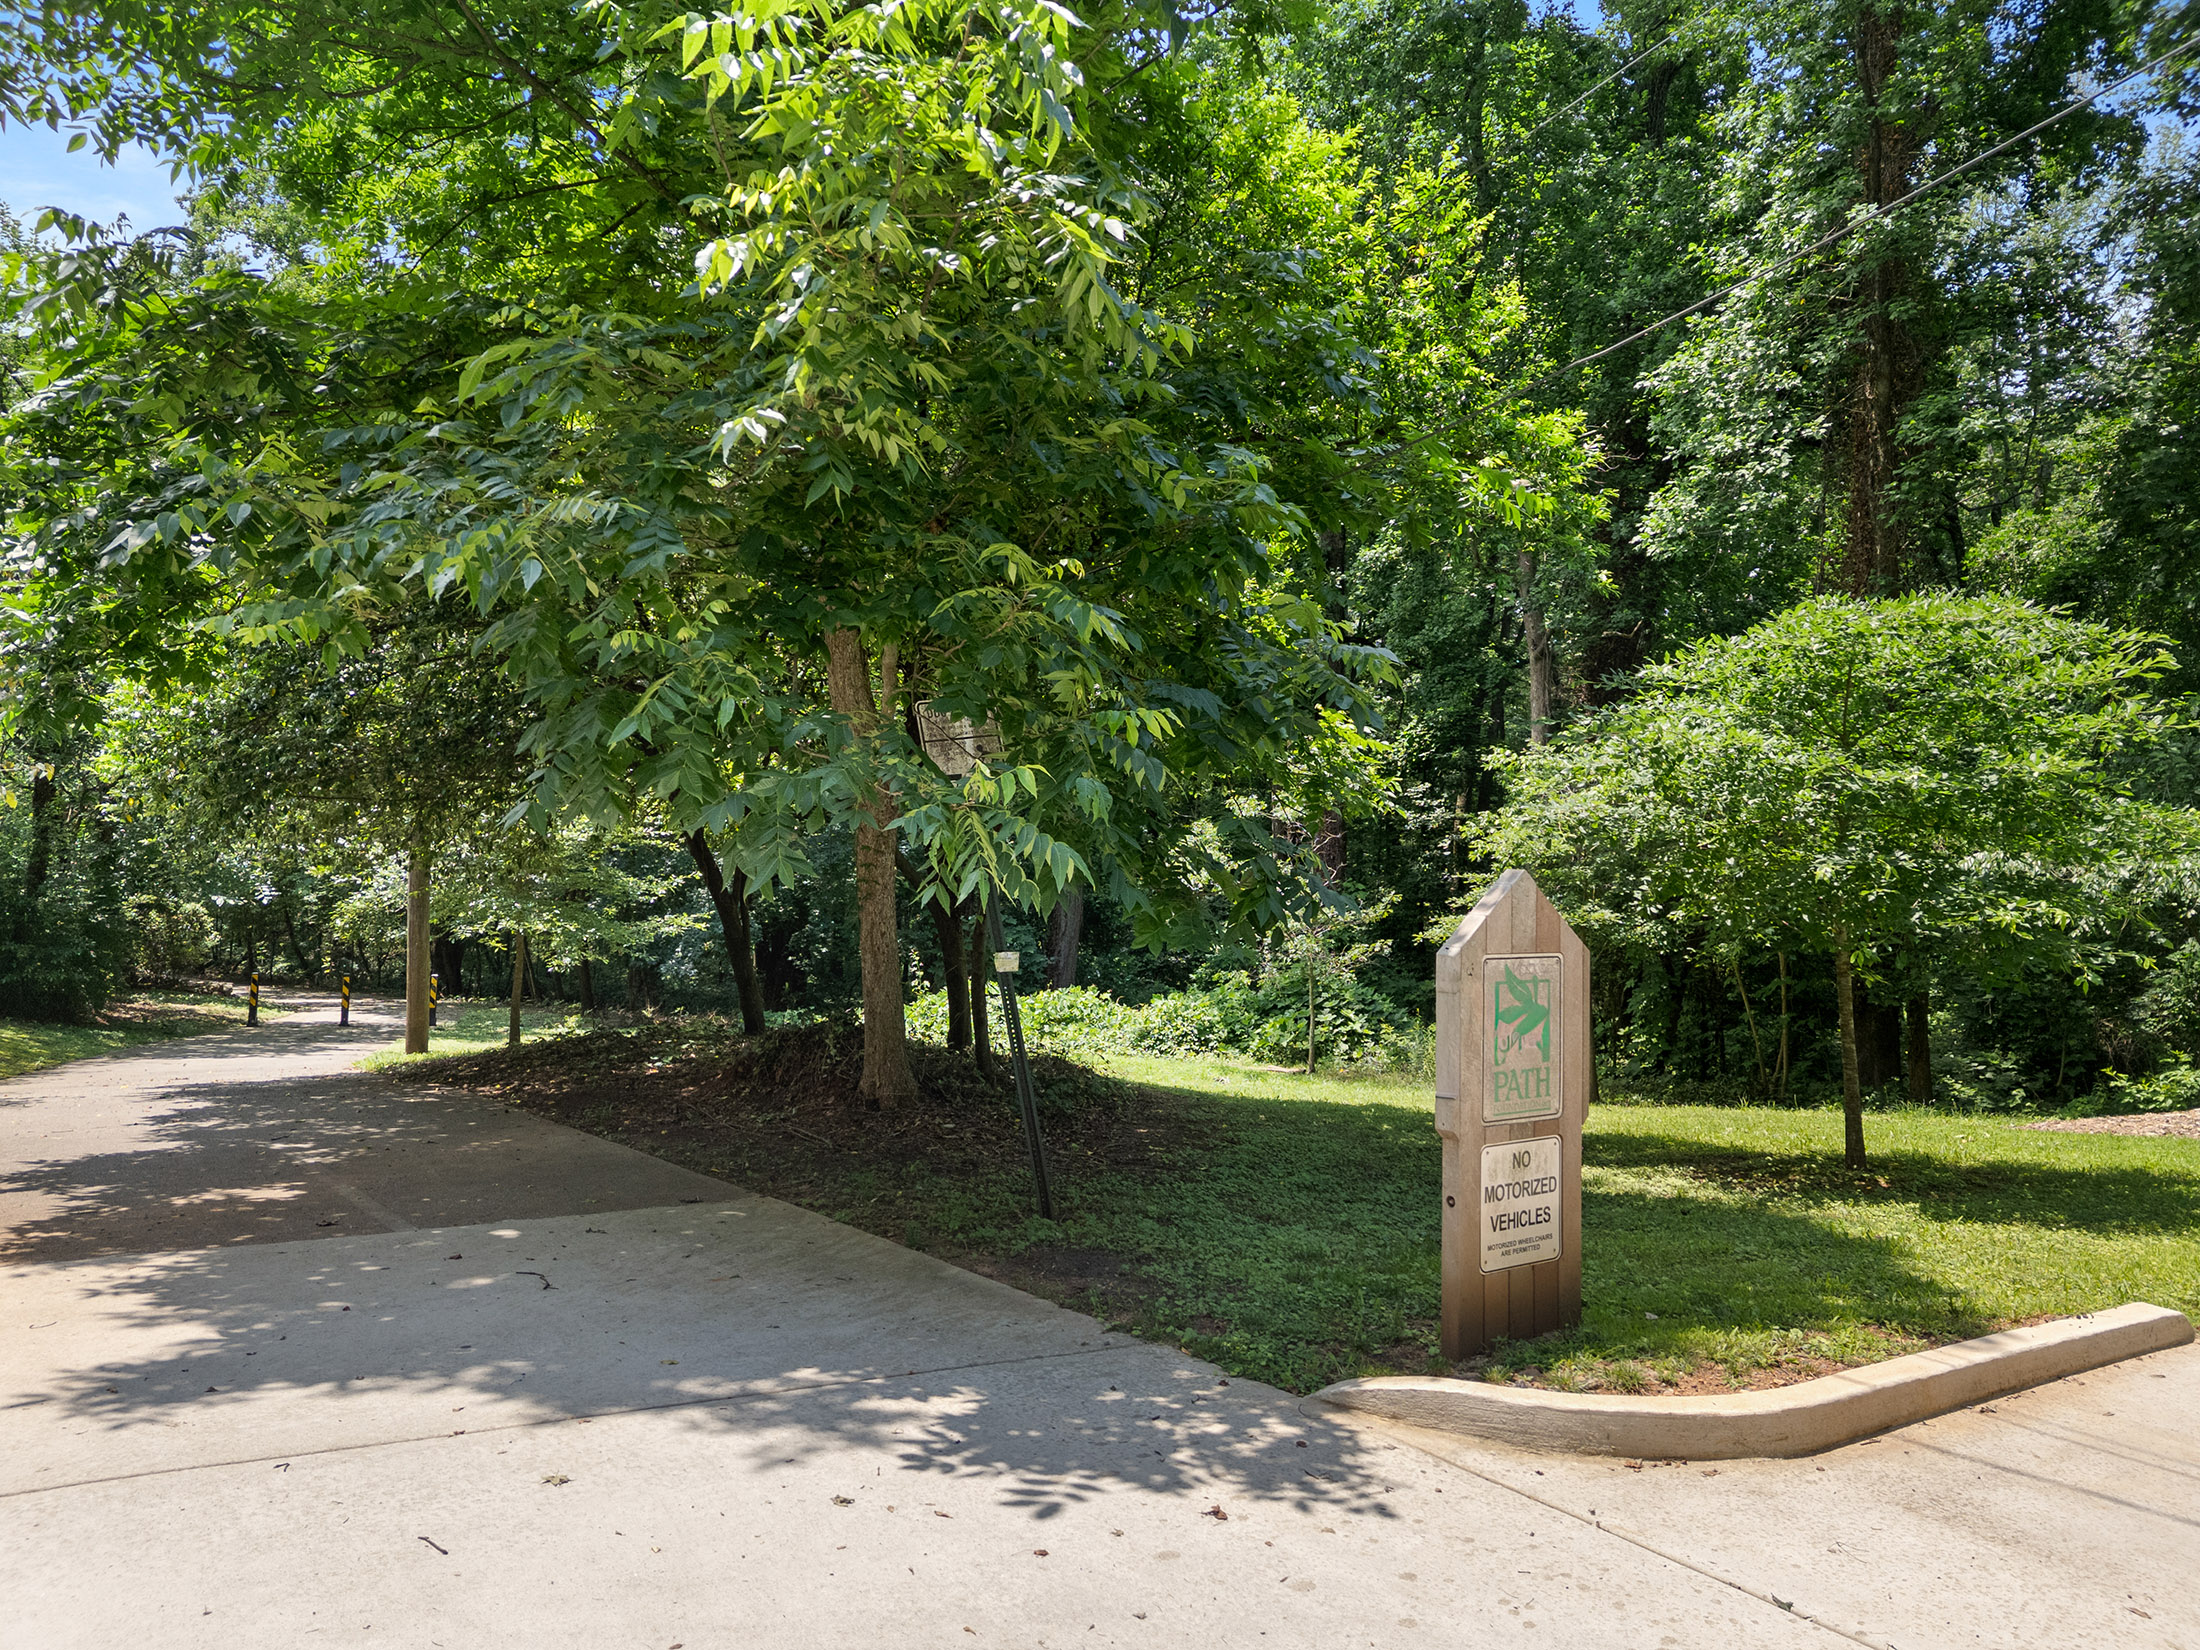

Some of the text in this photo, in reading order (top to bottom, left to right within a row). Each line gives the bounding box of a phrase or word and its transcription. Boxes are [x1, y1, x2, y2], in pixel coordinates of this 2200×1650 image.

[1494, 1066, 1551, 1103] PATH
[1512, 1150, 1531, 1169] NO
[1484, 1176, 1557, 1204] MOTORIZED
[1490, 1206, 1551, 1232] VEHICLES
[1487, 1233, 1553, 1251] MOTORIZED WHEELCHAIRS
[1501, 1243, 1541, 1257] ARE PERMITTED
